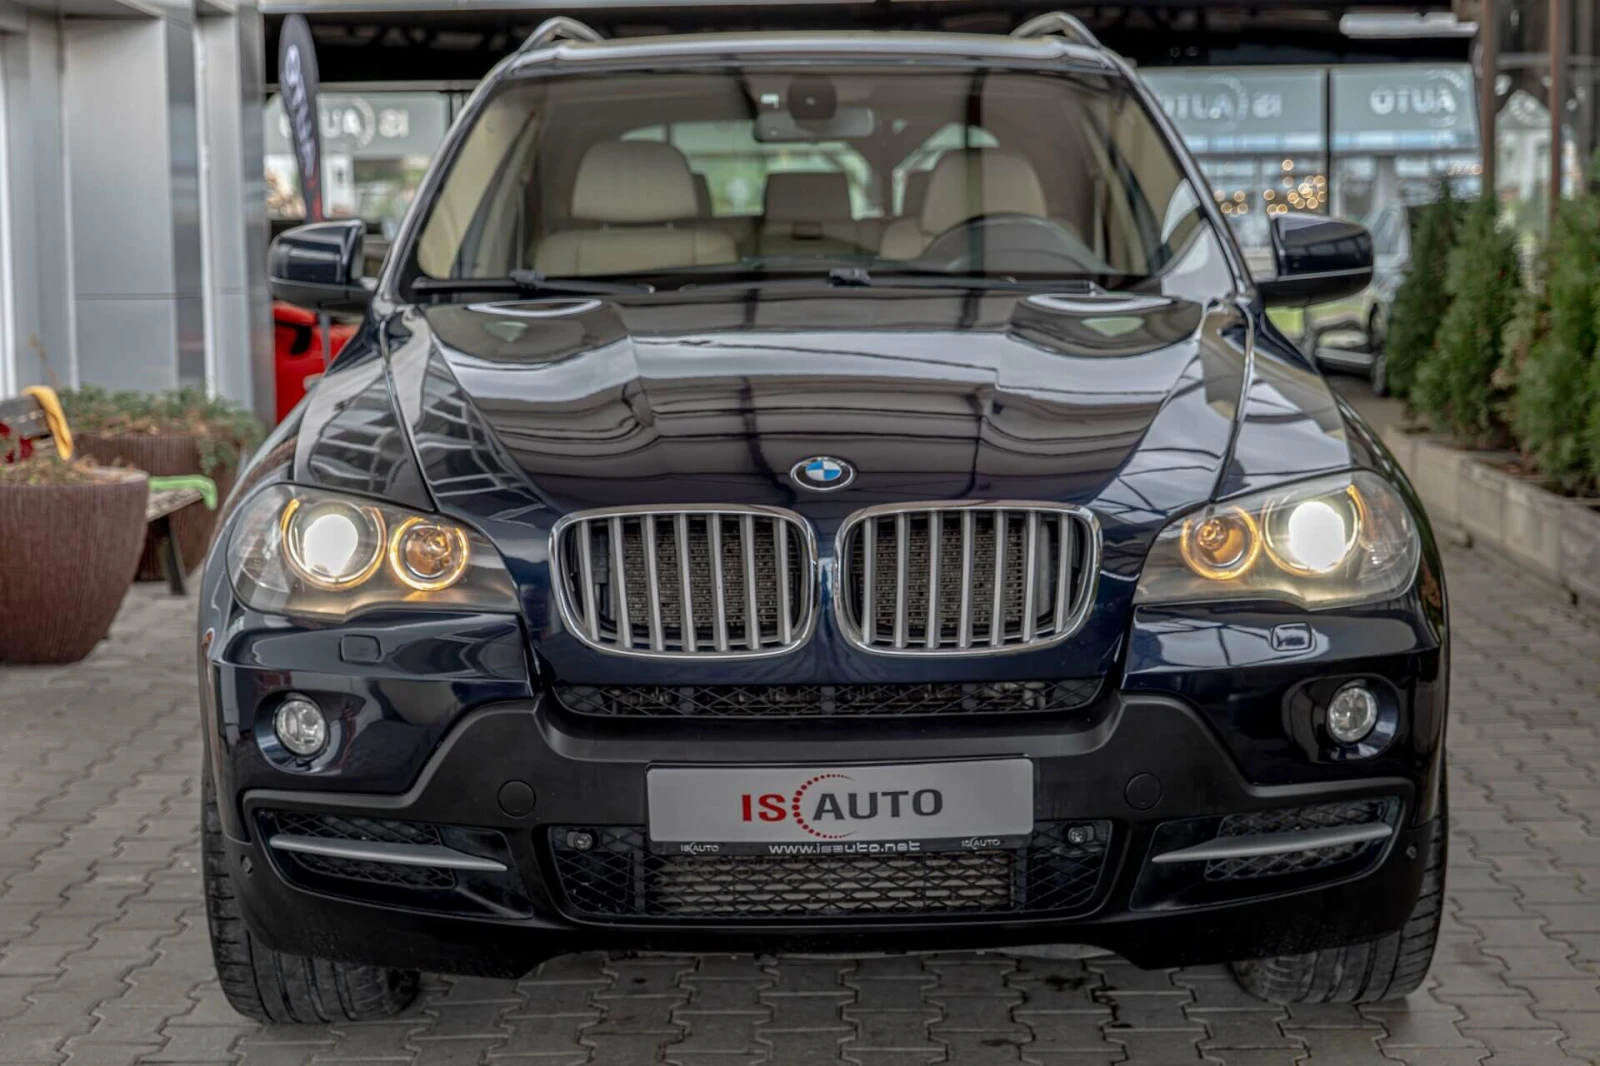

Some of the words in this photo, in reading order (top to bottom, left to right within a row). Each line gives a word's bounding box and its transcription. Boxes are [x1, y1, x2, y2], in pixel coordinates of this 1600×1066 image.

[741, 793, 787, 822] IS
[812, 788, 943, 821] AUTO
[768, 840, 921, 854] www.isauto.net
